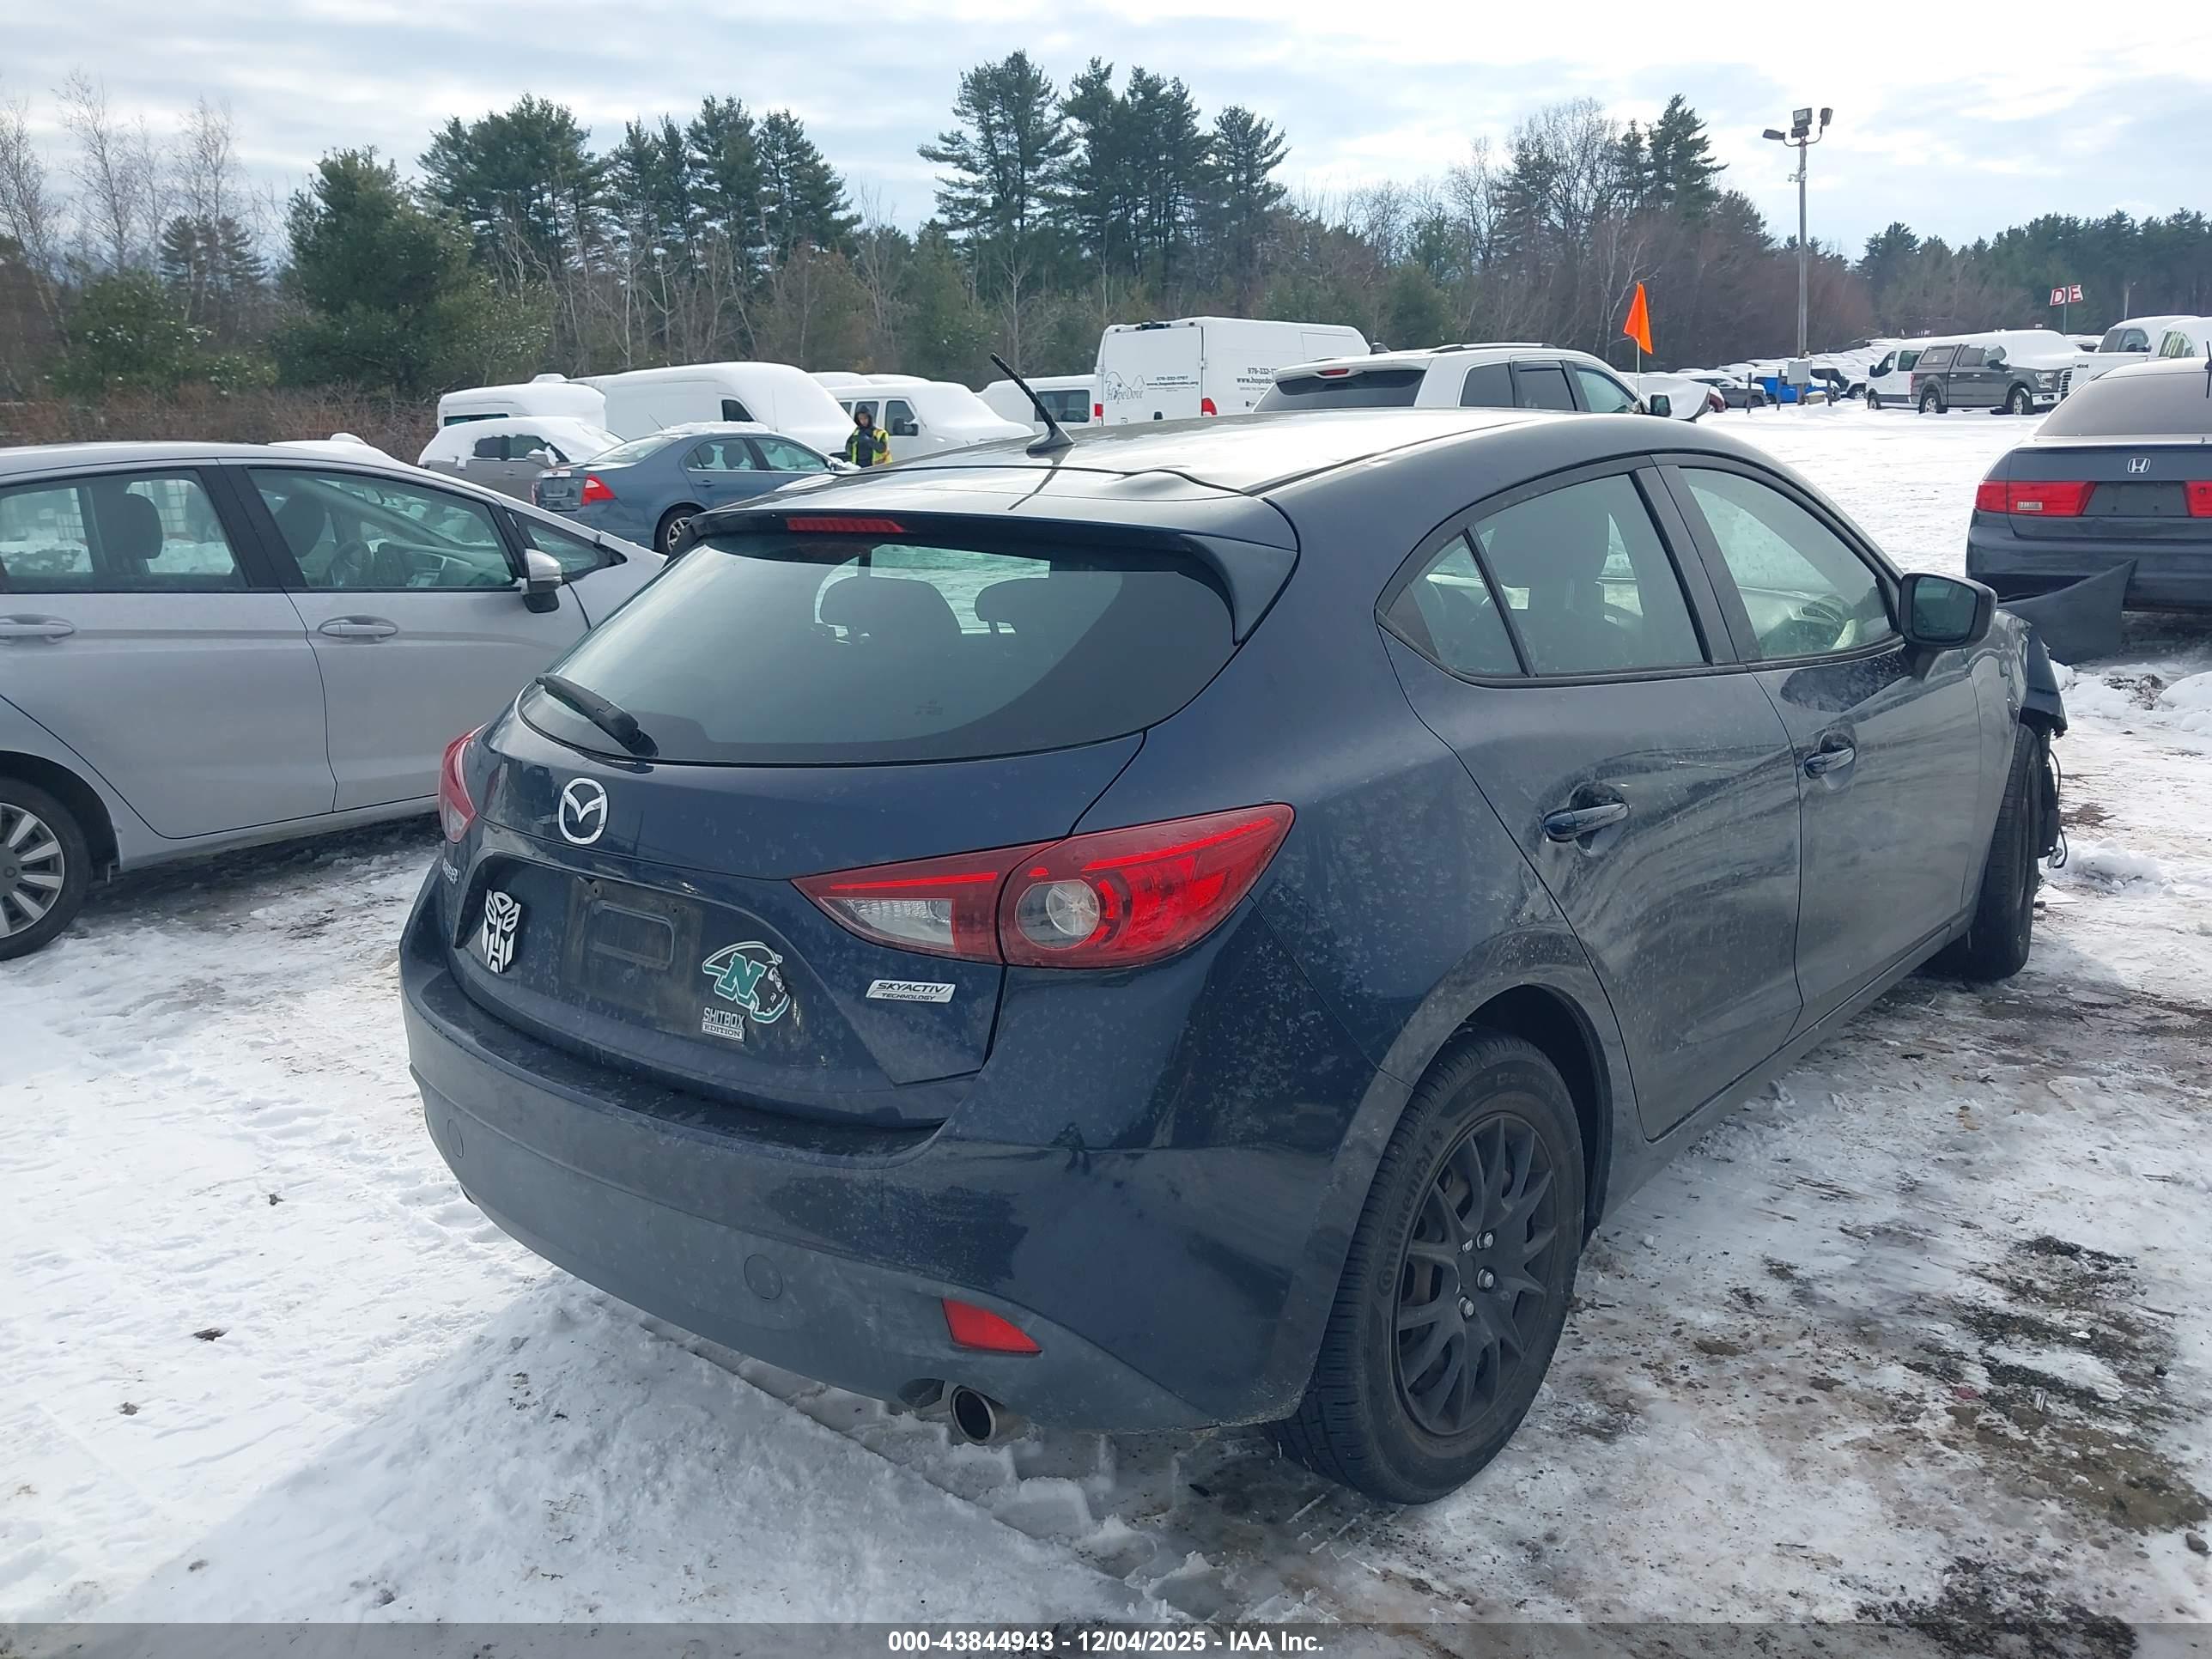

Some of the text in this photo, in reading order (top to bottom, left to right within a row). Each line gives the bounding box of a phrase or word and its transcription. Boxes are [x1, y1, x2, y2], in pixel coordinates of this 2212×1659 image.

[877, 982, 946, 993] SKYACTIV
[703, 1006, 745, 1030] SHITBOX
[704, 1024, 741, 1037] EDITION
